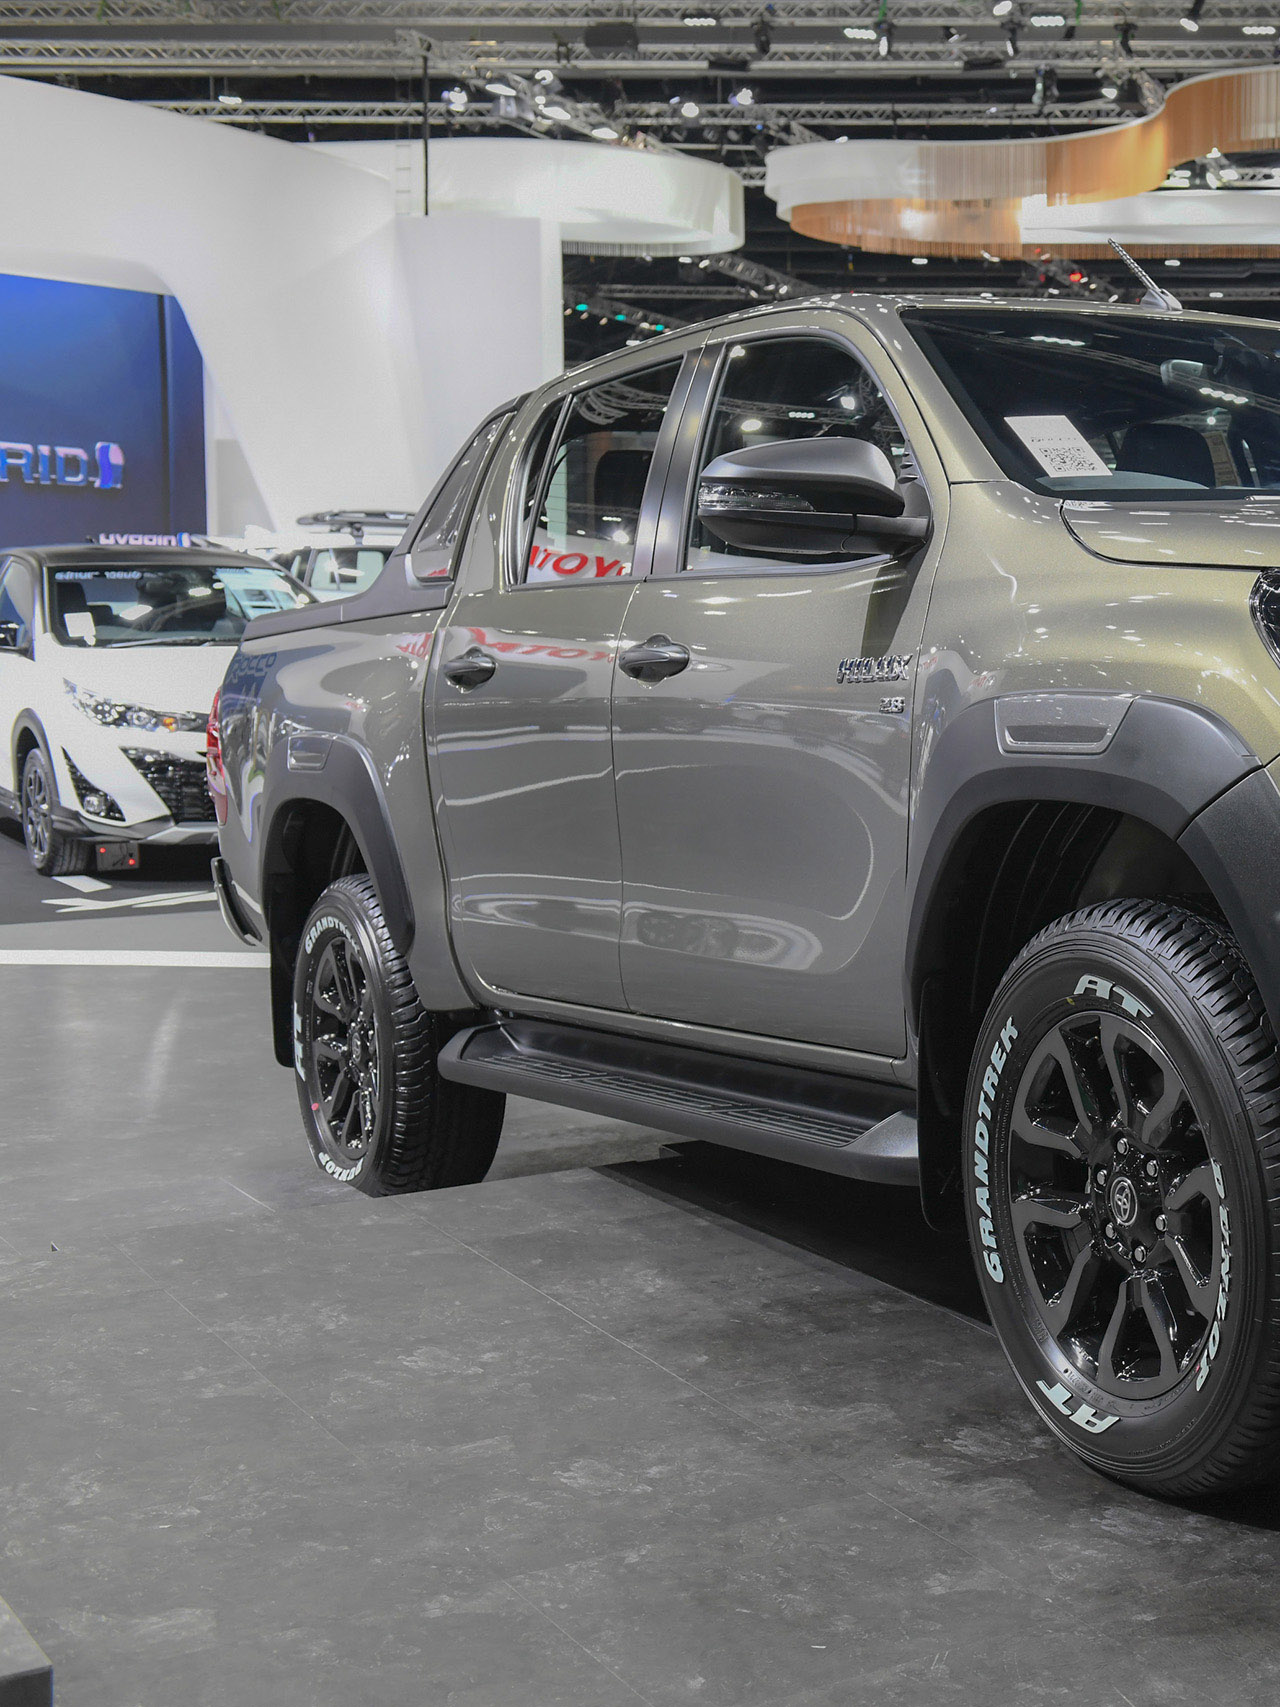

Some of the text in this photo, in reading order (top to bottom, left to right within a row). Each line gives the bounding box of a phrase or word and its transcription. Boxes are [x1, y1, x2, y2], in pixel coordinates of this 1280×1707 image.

[836, 654, 913, 684] HILUX
[1073, 973, 1154, 1019] AT
[318, 1151, 364, 1182] DUNLOP
[976, 1016, 1020, 1285] GRANDTREK
[1035, 1379, 1122, 1435] AT
